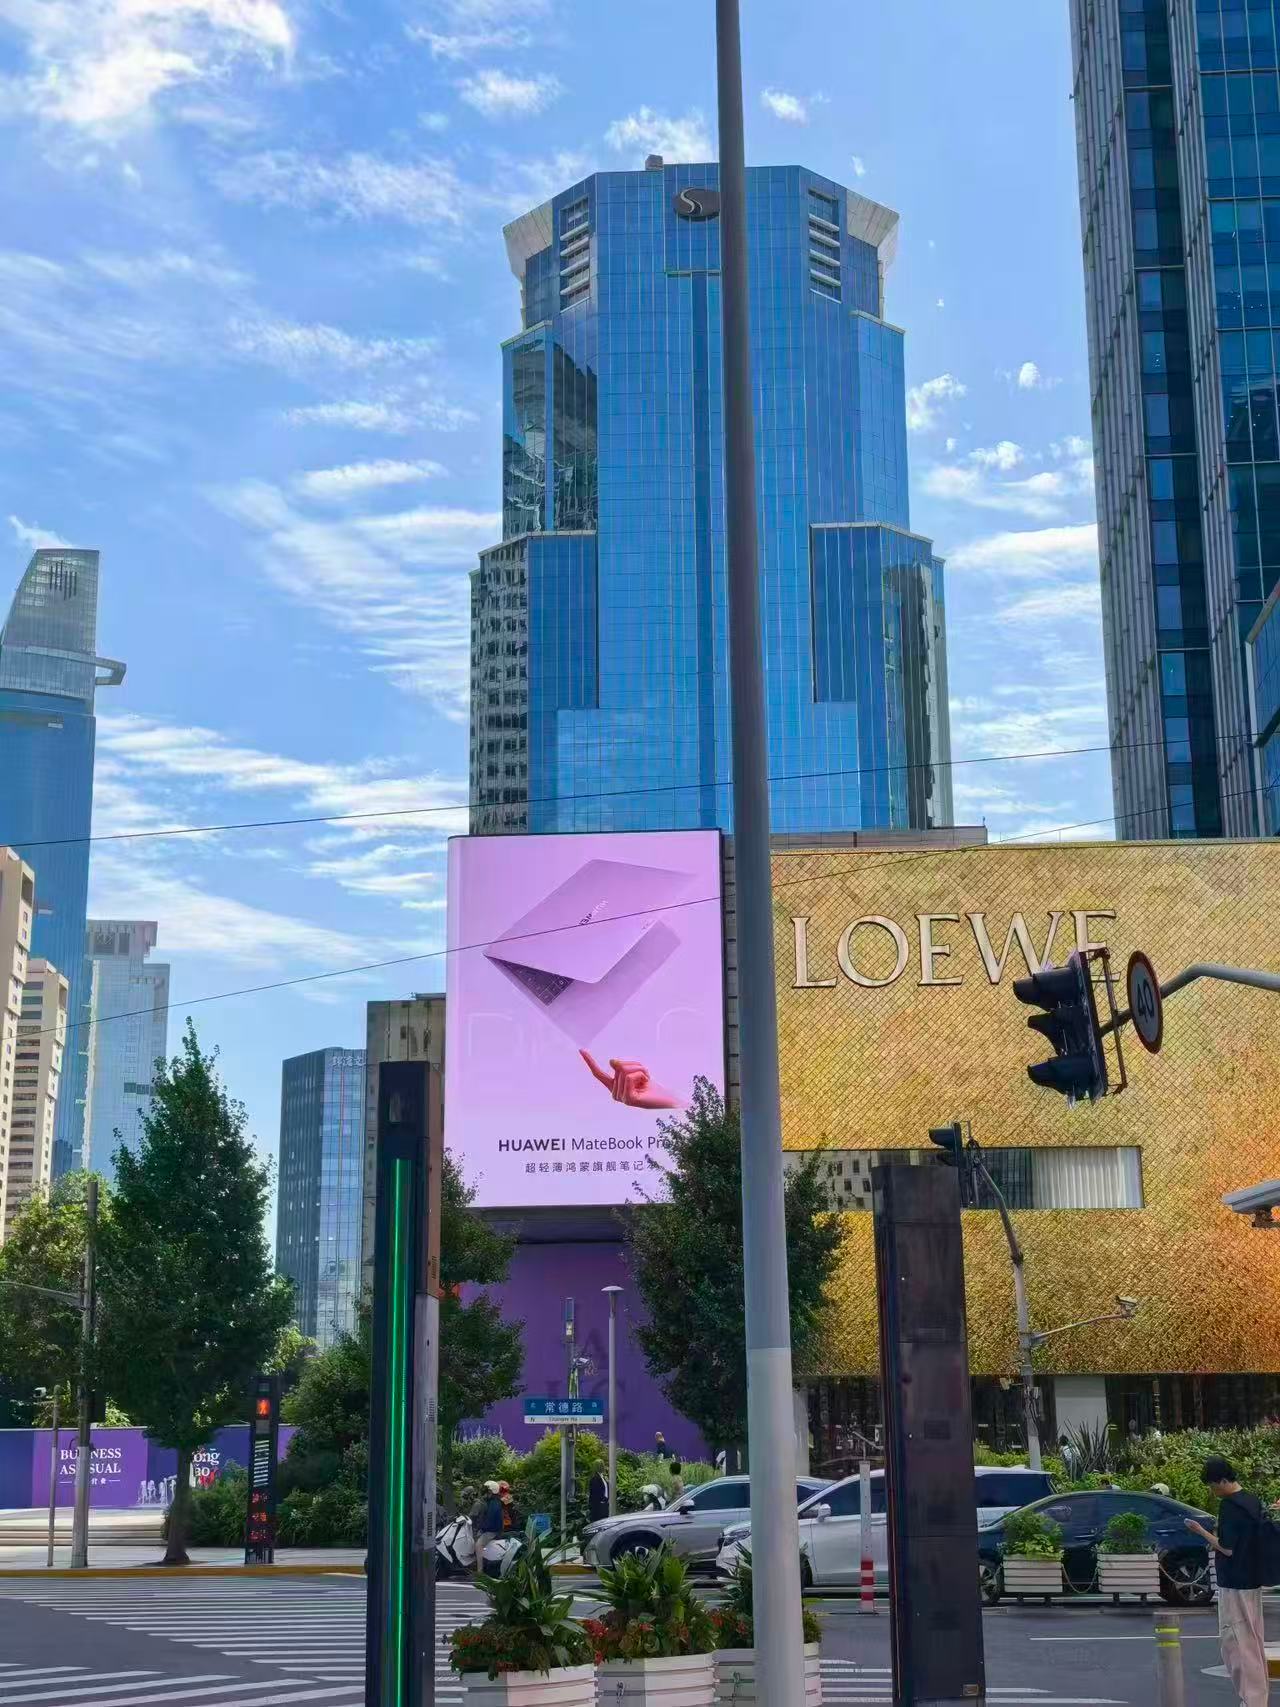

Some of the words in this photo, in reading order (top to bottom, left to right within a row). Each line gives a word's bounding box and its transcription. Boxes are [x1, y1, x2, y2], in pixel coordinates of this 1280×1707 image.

[790, 908, 1122, 989] LOEWE
[1136, 978, 1155, 1024] 40
[498, 1138, 566, 1152] HUAWEI
[571, 1136, 643, 1151] MateBook
[544, 1401, 583, 1414] 常德路
[60, 1448, 122, 1460] BUNESS
[59, 1464, 76, 1475] AS
[89, 1463, 122, 1474] SUAL
